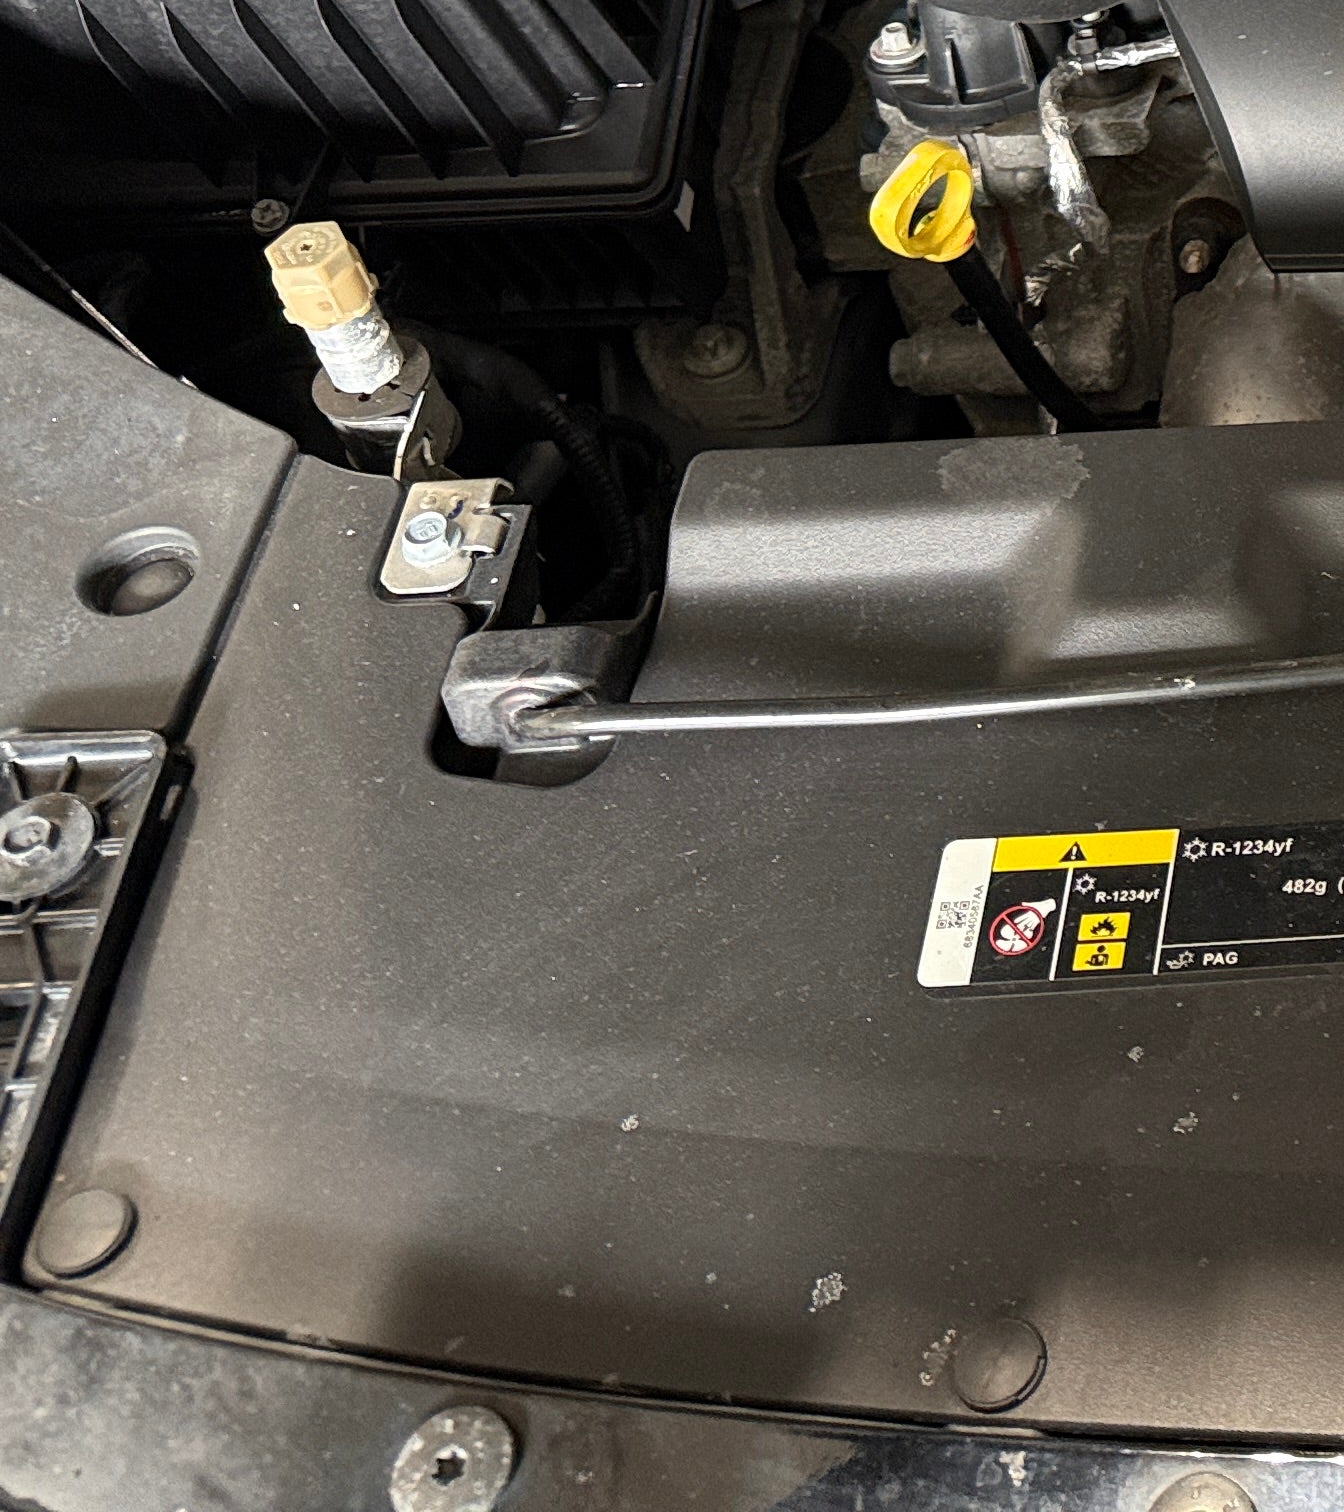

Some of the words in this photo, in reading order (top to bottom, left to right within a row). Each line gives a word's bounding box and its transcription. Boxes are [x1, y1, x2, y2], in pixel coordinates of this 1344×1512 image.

[1211, 838, 1294, 856] R-1234yf
[1282, 878, 1327, 895] 482g
[1095, 888, 1160, 903] R-1234yf
[1202, 951, 1239, 966] PAG
